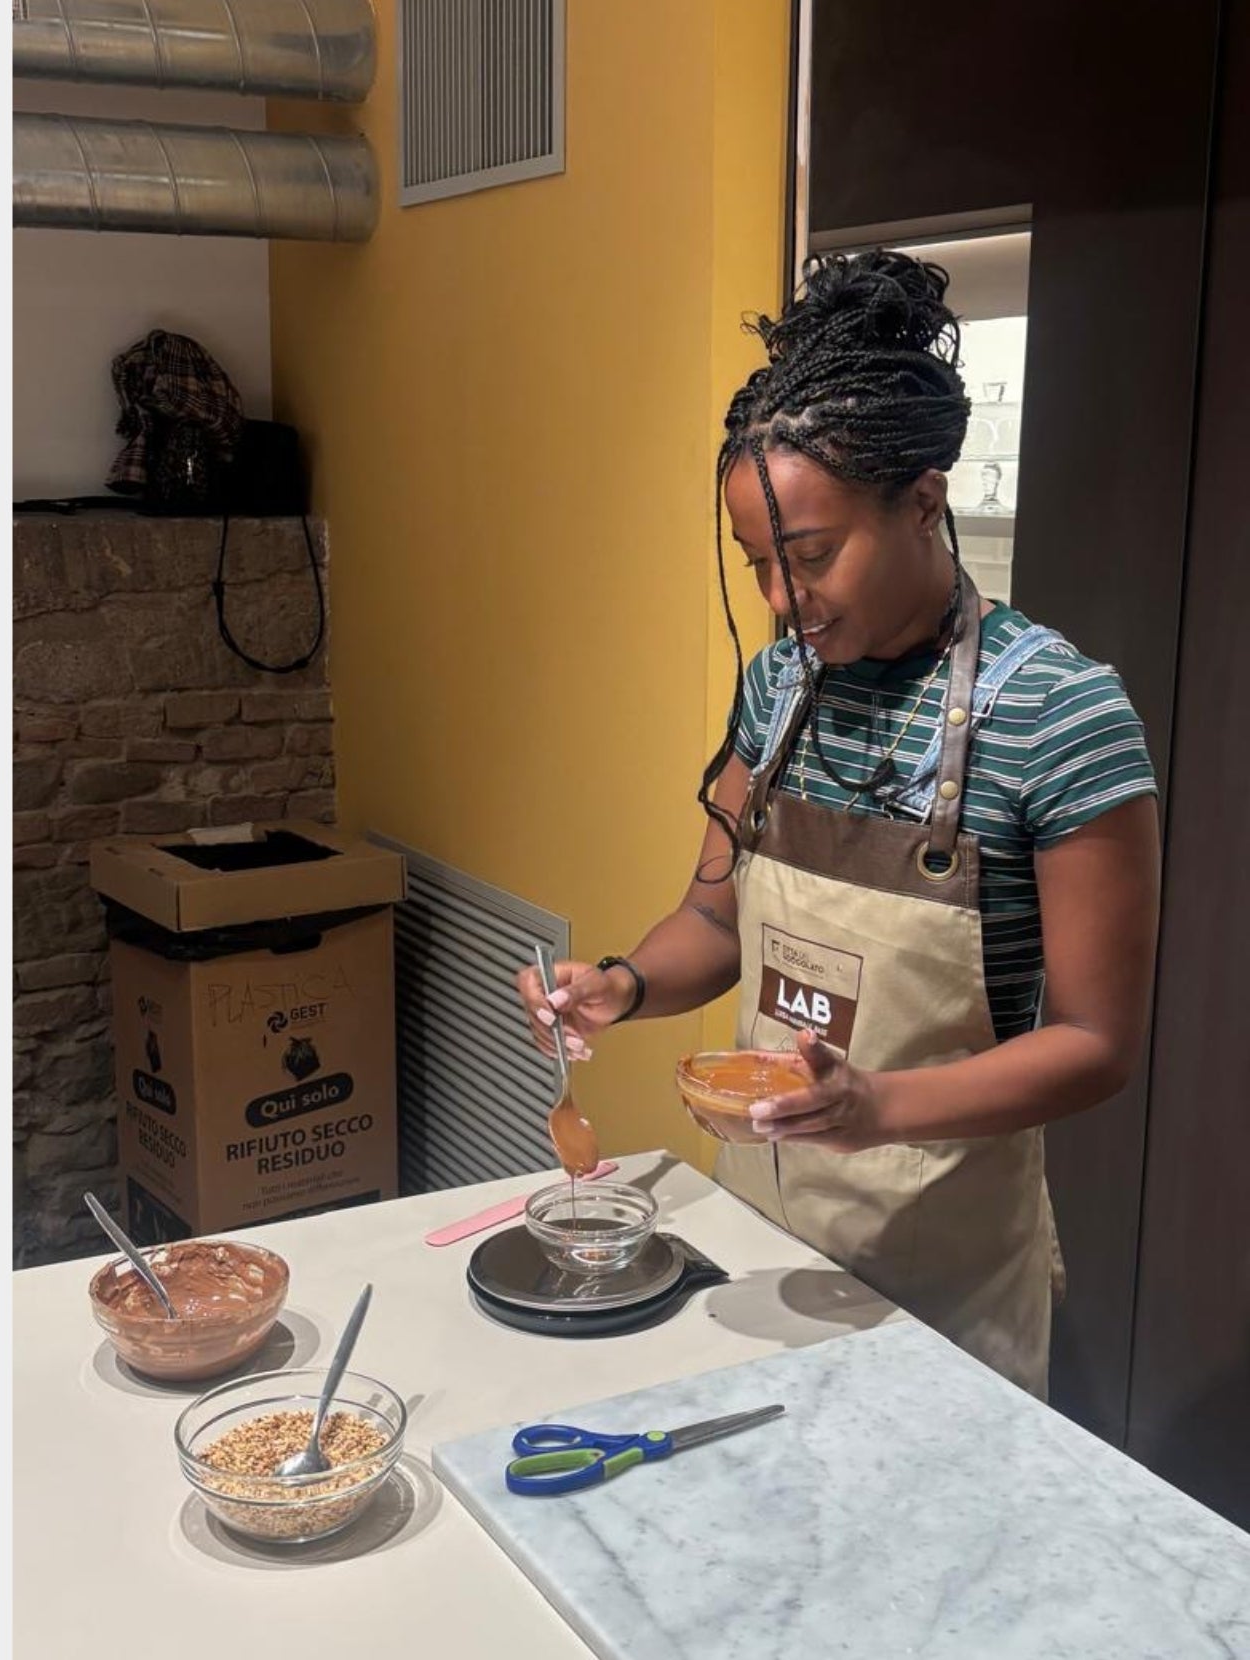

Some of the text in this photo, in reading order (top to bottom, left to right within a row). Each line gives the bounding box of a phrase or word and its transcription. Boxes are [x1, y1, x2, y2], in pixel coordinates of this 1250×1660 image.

[207, 965, 356, 1027] PLASTICA
[290, 1002, 328, 1021] GEST
[776, 977, 832, 1025] LAB
[261, 1084, 340, 1119] Qui solo
[226, 1113, 374, 1162] RIFIUTO SECCO
[257, 1140, 345, 1175] RESIDUO
